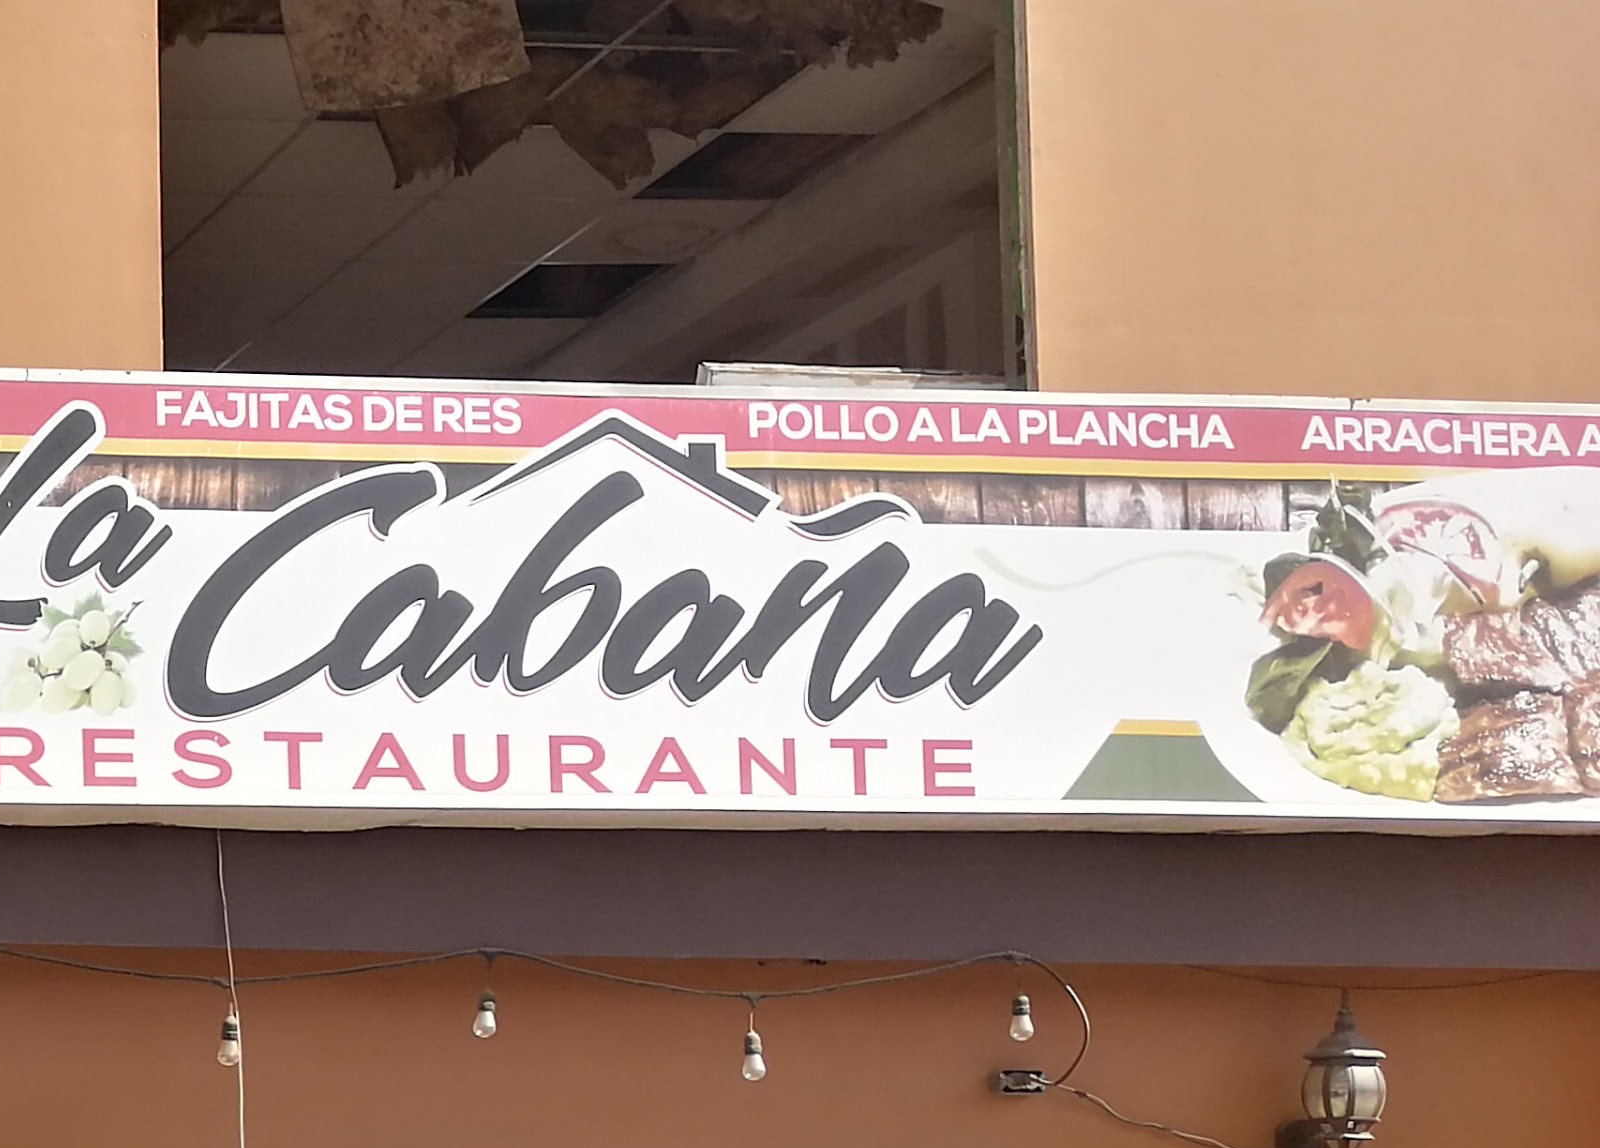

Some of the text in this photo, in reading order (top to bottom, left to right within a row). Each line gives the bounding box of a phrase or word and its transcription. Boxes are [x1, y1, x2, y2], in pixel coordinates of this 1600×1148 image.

[155, 389, 523, 435] FAJITAS DE RES
[747, 401, 1235, 450] POLLO A LA PLANCHA
[1300, 414, 1572, 458] ARRACHERA
[167, 468, 1044, 724] Cabaña
